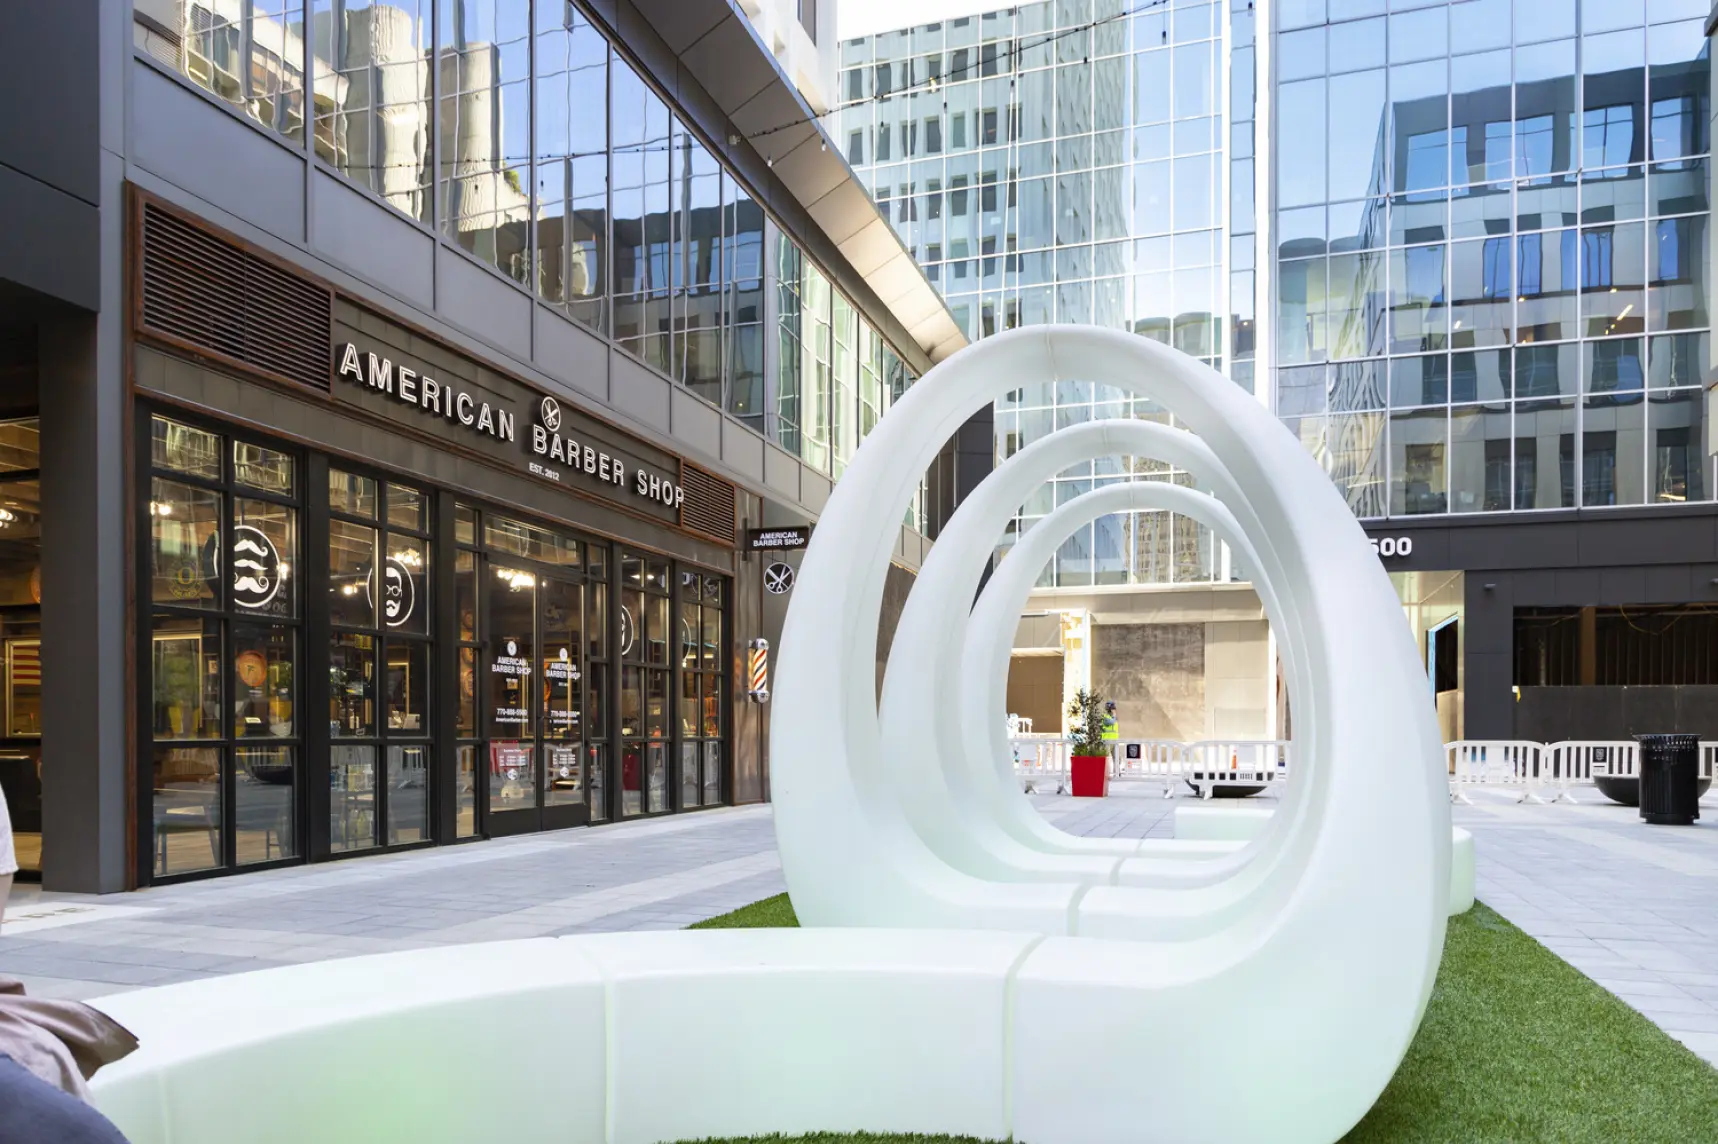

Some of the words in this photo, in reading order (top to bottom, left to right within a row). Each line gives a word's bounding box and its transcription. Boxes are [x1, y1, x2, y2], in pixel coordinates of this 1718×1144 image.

[339, 342, 514, 442] AMERICAN
[533, 424, 625, 486] BARBER
[637, 469, 685, 508] SHOP
[528, 462, 543, 475] EST.
[544, 468, 560, 481] 2012
[760, 531, 798, 539] AMERICAN
[753, 539, 783, 547] BARBER
[784, 537, 805, 546] SHOP
[497, 656, 527, 666] AMERICAN
[491, 664, 515, 674] BARBER
[516, 666, 532, 675] SHOP
